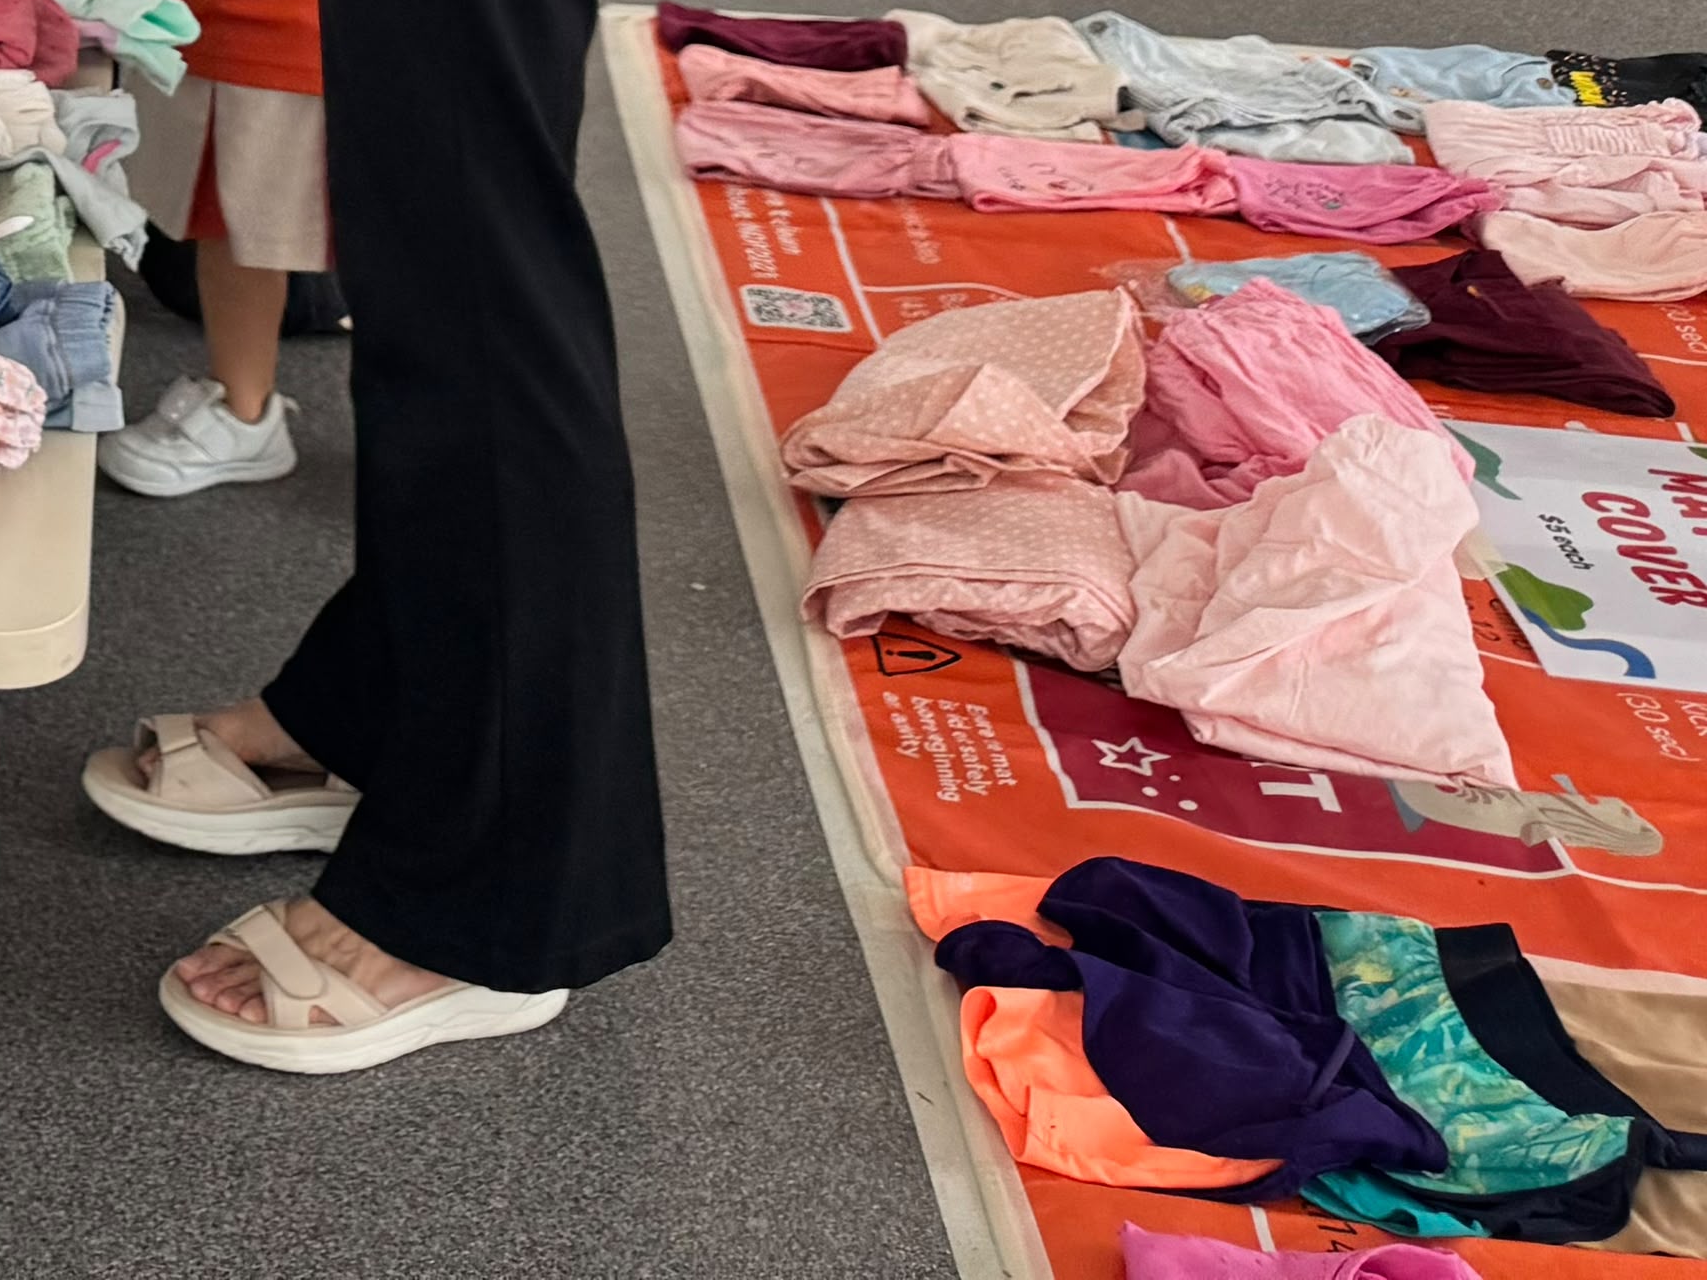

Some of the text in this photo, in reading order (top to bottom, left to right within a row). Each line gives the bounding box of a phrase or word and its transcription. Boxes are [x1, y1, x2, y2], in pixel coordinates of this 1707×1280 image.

[1537, 513, 1595, 571] $5 each
[1581, 491, 1707, 608] COVER
[1616, 692, 1702, 762] (30 sec)
[958, 745, 993, 796] safely
[989, 752, 1018, 786] mat
